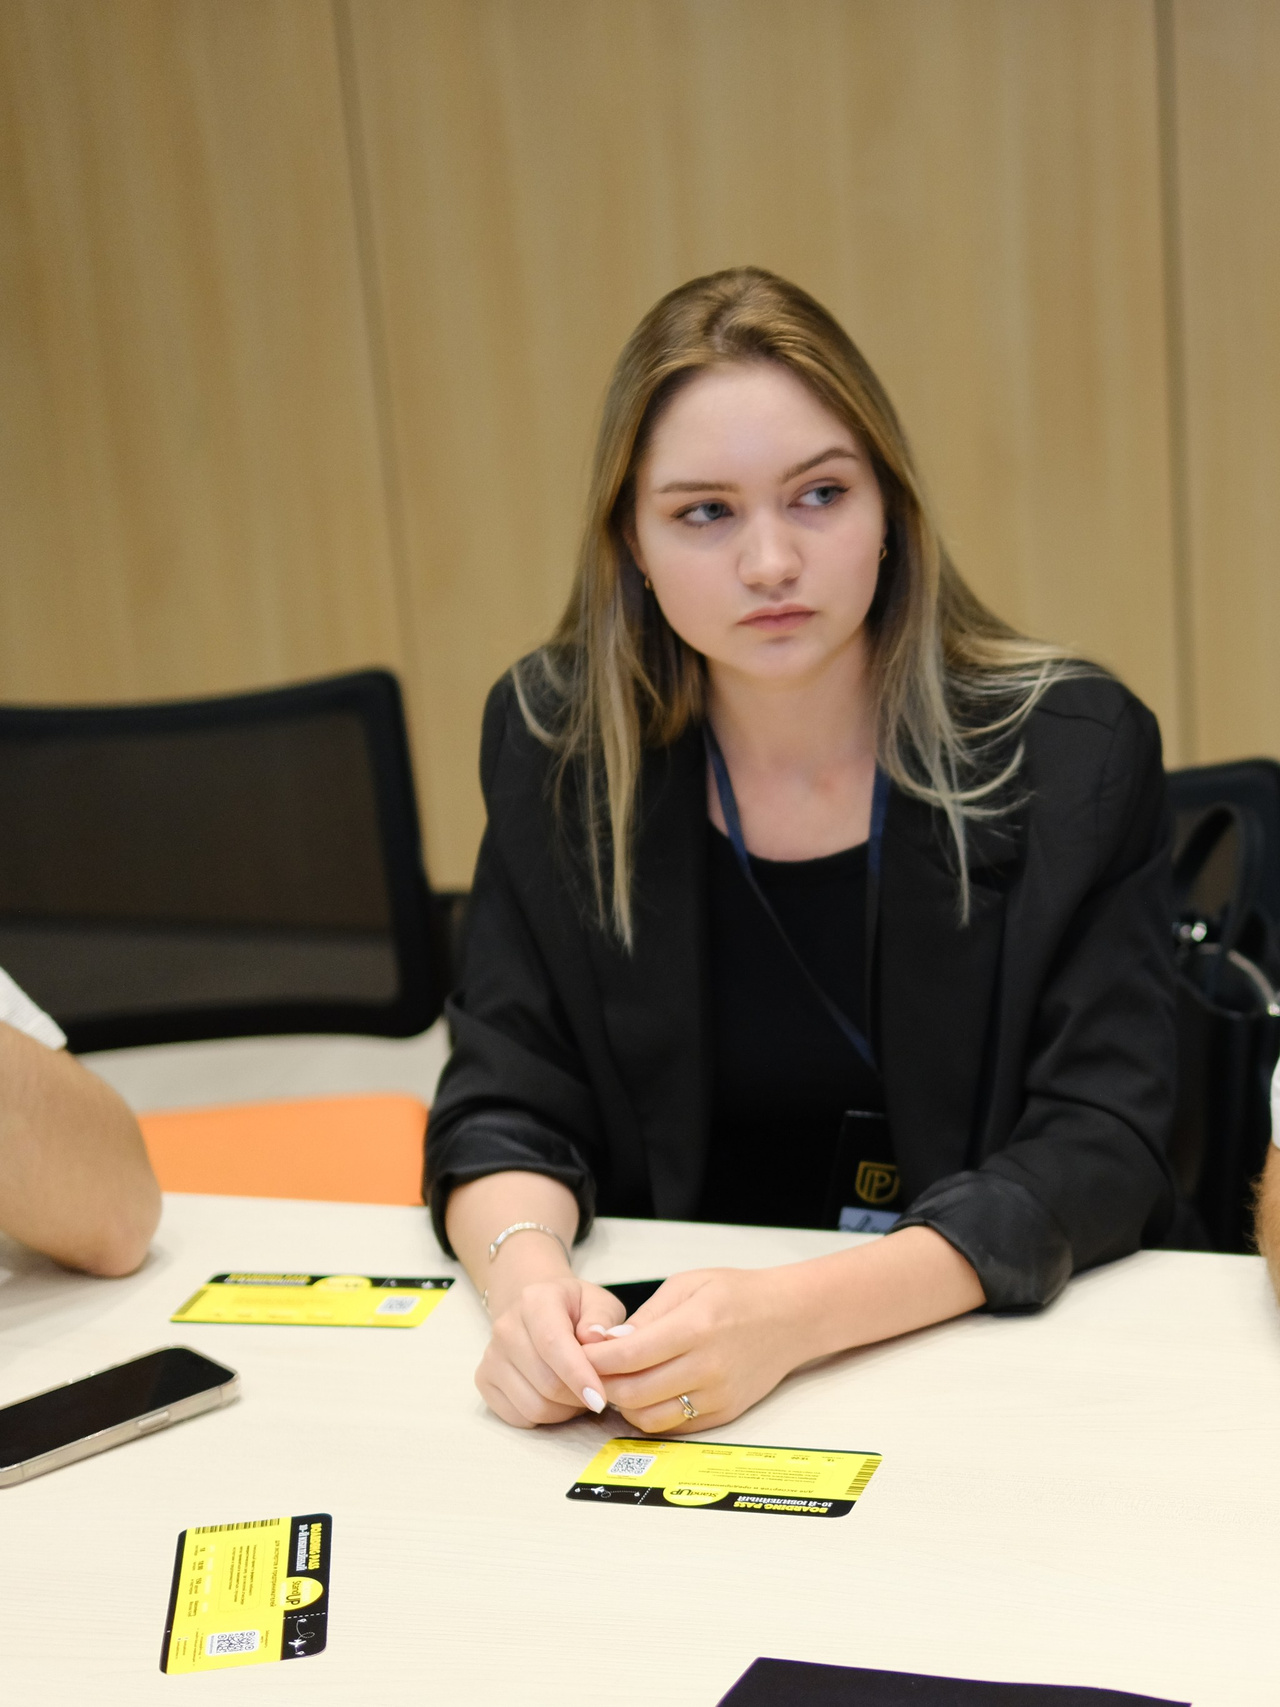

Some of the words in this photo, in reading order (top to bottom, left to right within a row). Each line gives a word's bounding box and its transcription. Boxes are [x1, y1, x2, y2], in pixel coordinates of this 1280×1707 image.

[733, 1501, 763, 1510] PASS
[737, 1495, 808, 1506] ЮБИЛЕЙНЫЙ
[763, 1502, 829, 1514] BOARDING
